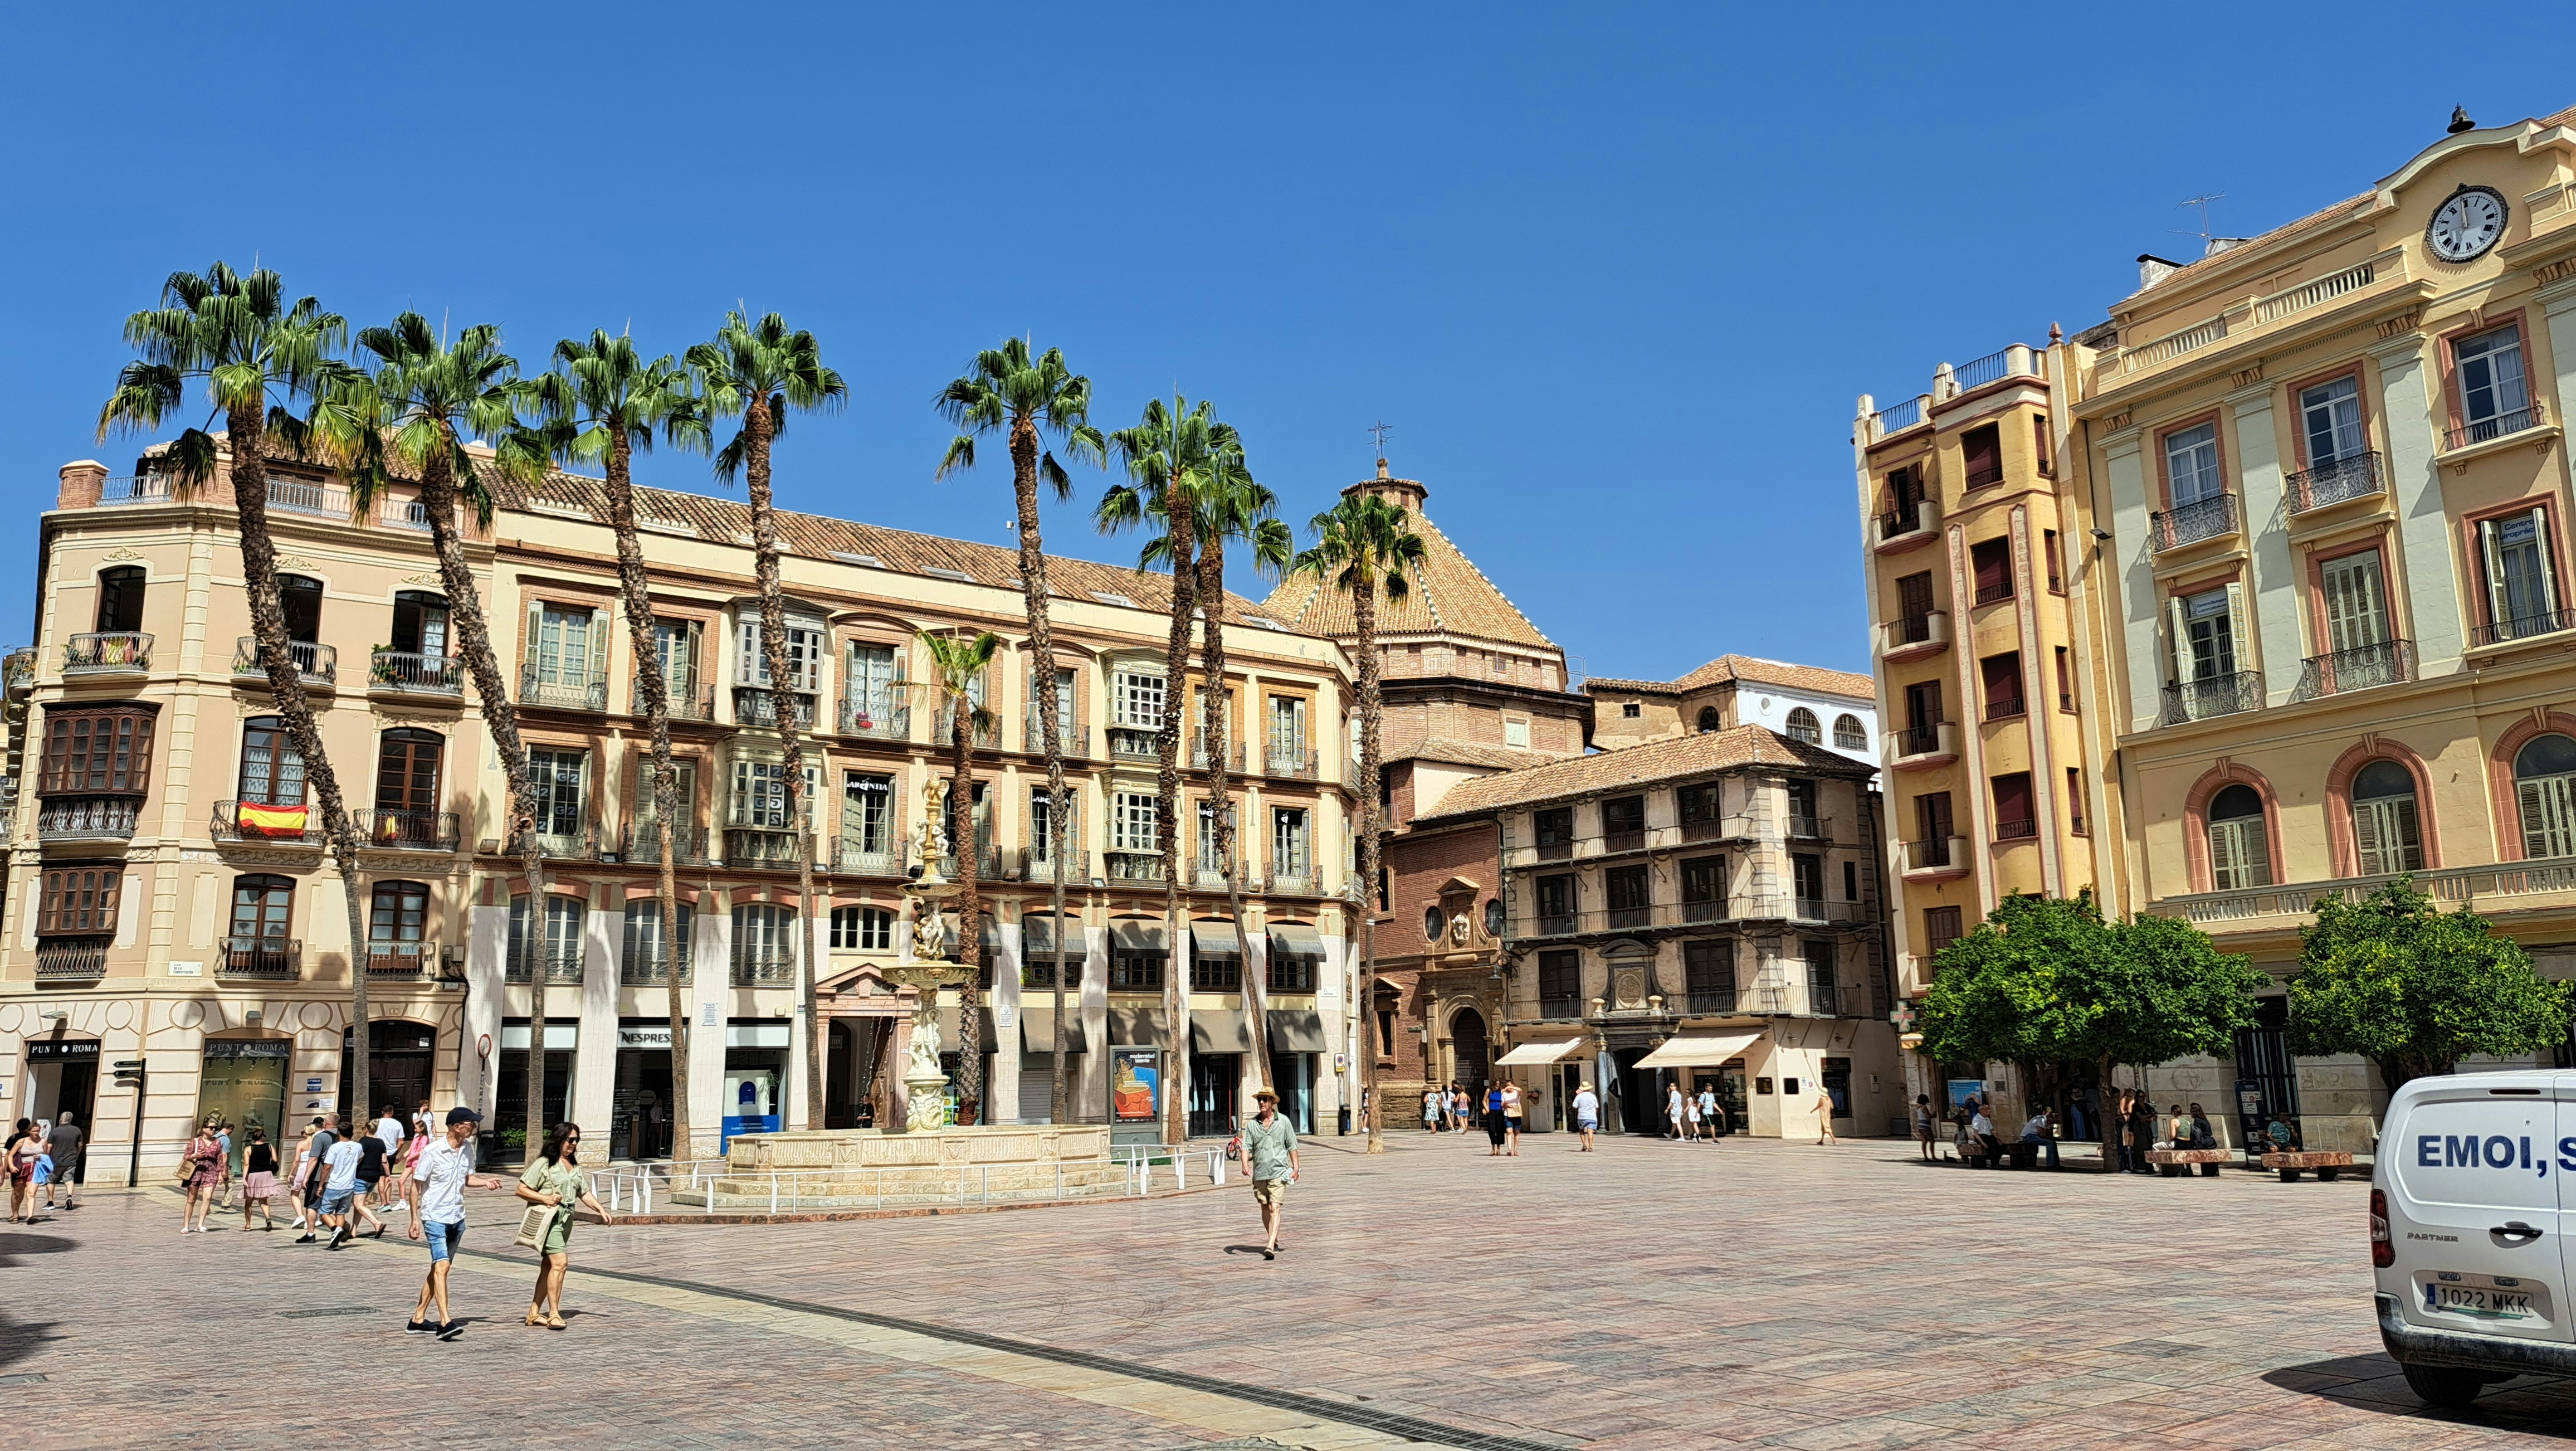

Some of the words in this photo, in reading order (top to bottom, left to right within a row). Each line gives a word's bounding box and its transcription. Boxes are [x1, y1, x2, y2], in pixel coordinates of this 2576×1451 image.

[2504, 519, 2534, 530] Centro
[2500, 527, 2535, 541] uiroprác
[755, 765, 781, 777] G2
[557, 772, 579, 783] G2
[555, 806, 576, 816] G2
[619, 1031, 672, 1044] NESPRES
[2407, 1232, 2458, 1243] PARTNER
[2441, 1288, 2485, 1309] 1022
[2492, 1293, 2528, 1313] MKK
